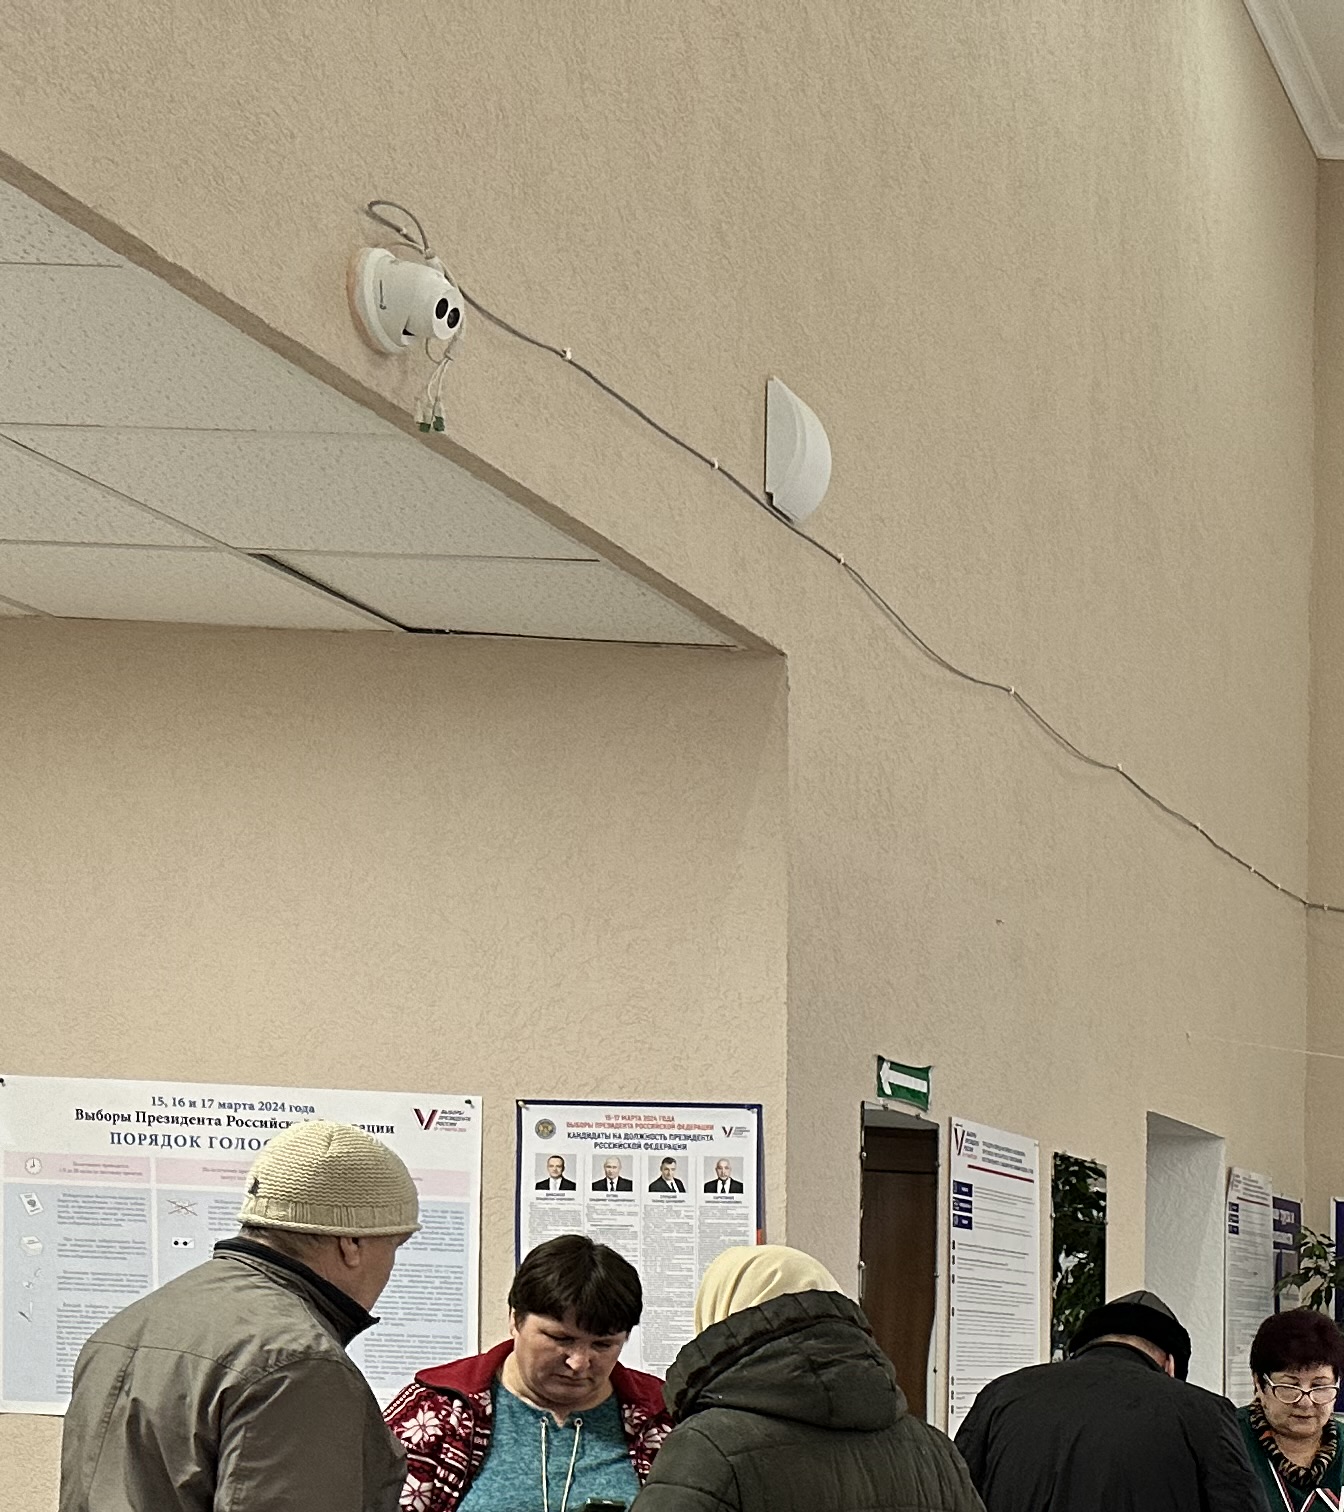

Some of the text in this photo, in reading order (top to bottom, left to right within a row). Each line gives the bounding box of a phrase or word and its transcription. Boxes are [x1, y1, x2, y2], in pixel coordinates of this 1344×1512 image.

[151, 1096, 168, 1108] 15,
[172, 1097, 185, 1108] 16
[201, 1098, 215, 1109] 17
[217, 1101, 255, 1113] марта
[257, 1101, 286, 1112] 2024
[289, 1104, 315, 1114] года
[75, 1108, 131, 1125] Выборы
[135, 1110, 222, 1127] Президента
[110, 1131, 201, 1149] ПОРЯДОК
